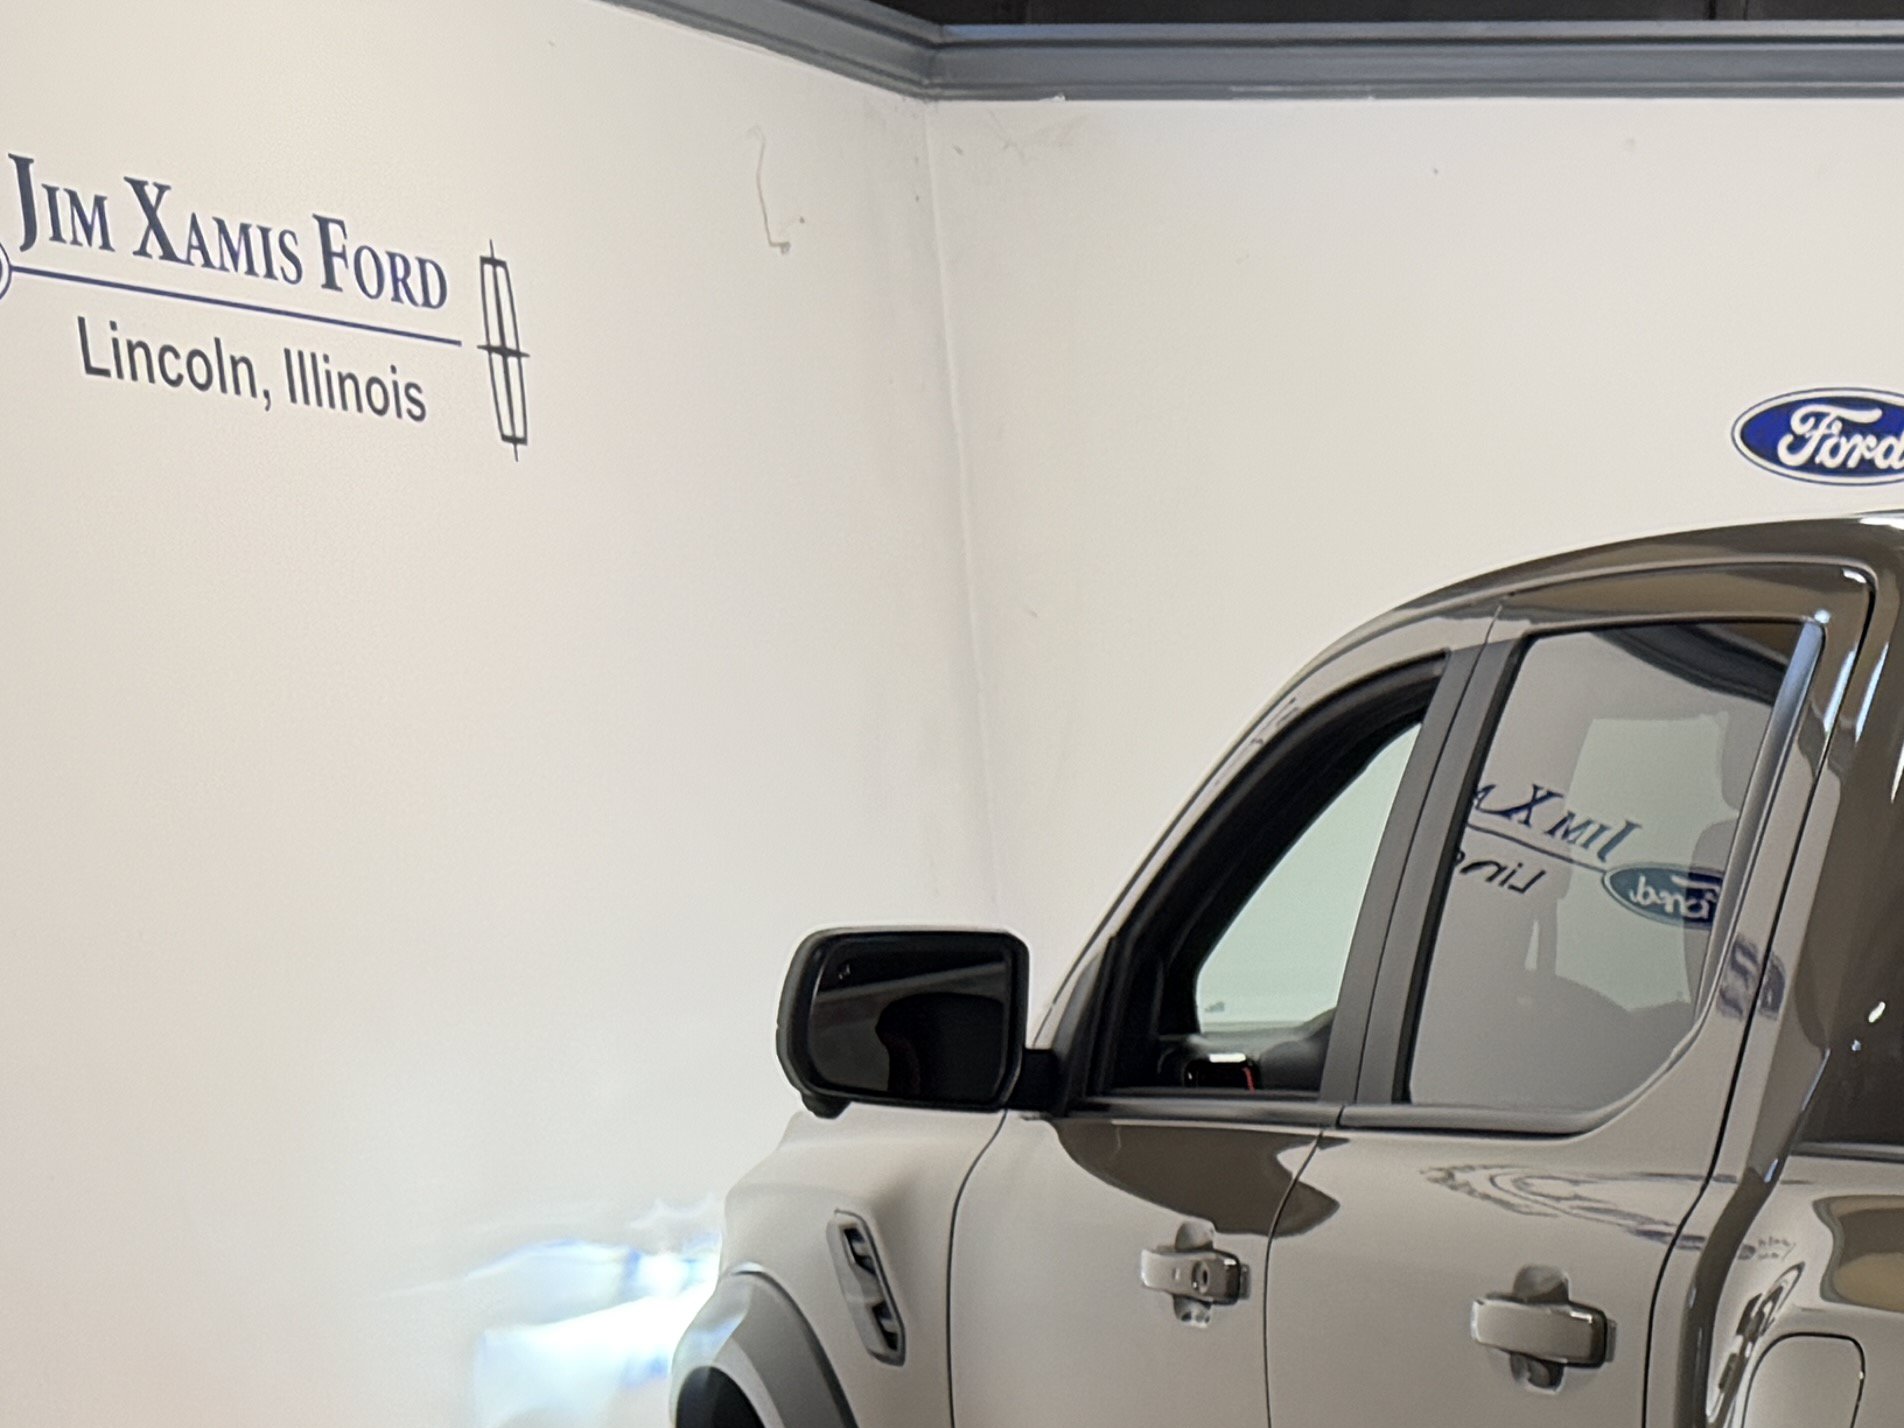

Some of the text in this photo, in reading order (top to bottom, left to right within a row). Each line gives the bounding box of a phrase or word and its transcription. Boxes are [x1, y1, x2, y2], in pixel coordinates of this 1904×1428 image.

[8, 153, 448, 309] JIM XAMIS FORD
[77, 315, 428, 422] Lincoln, Illinois
